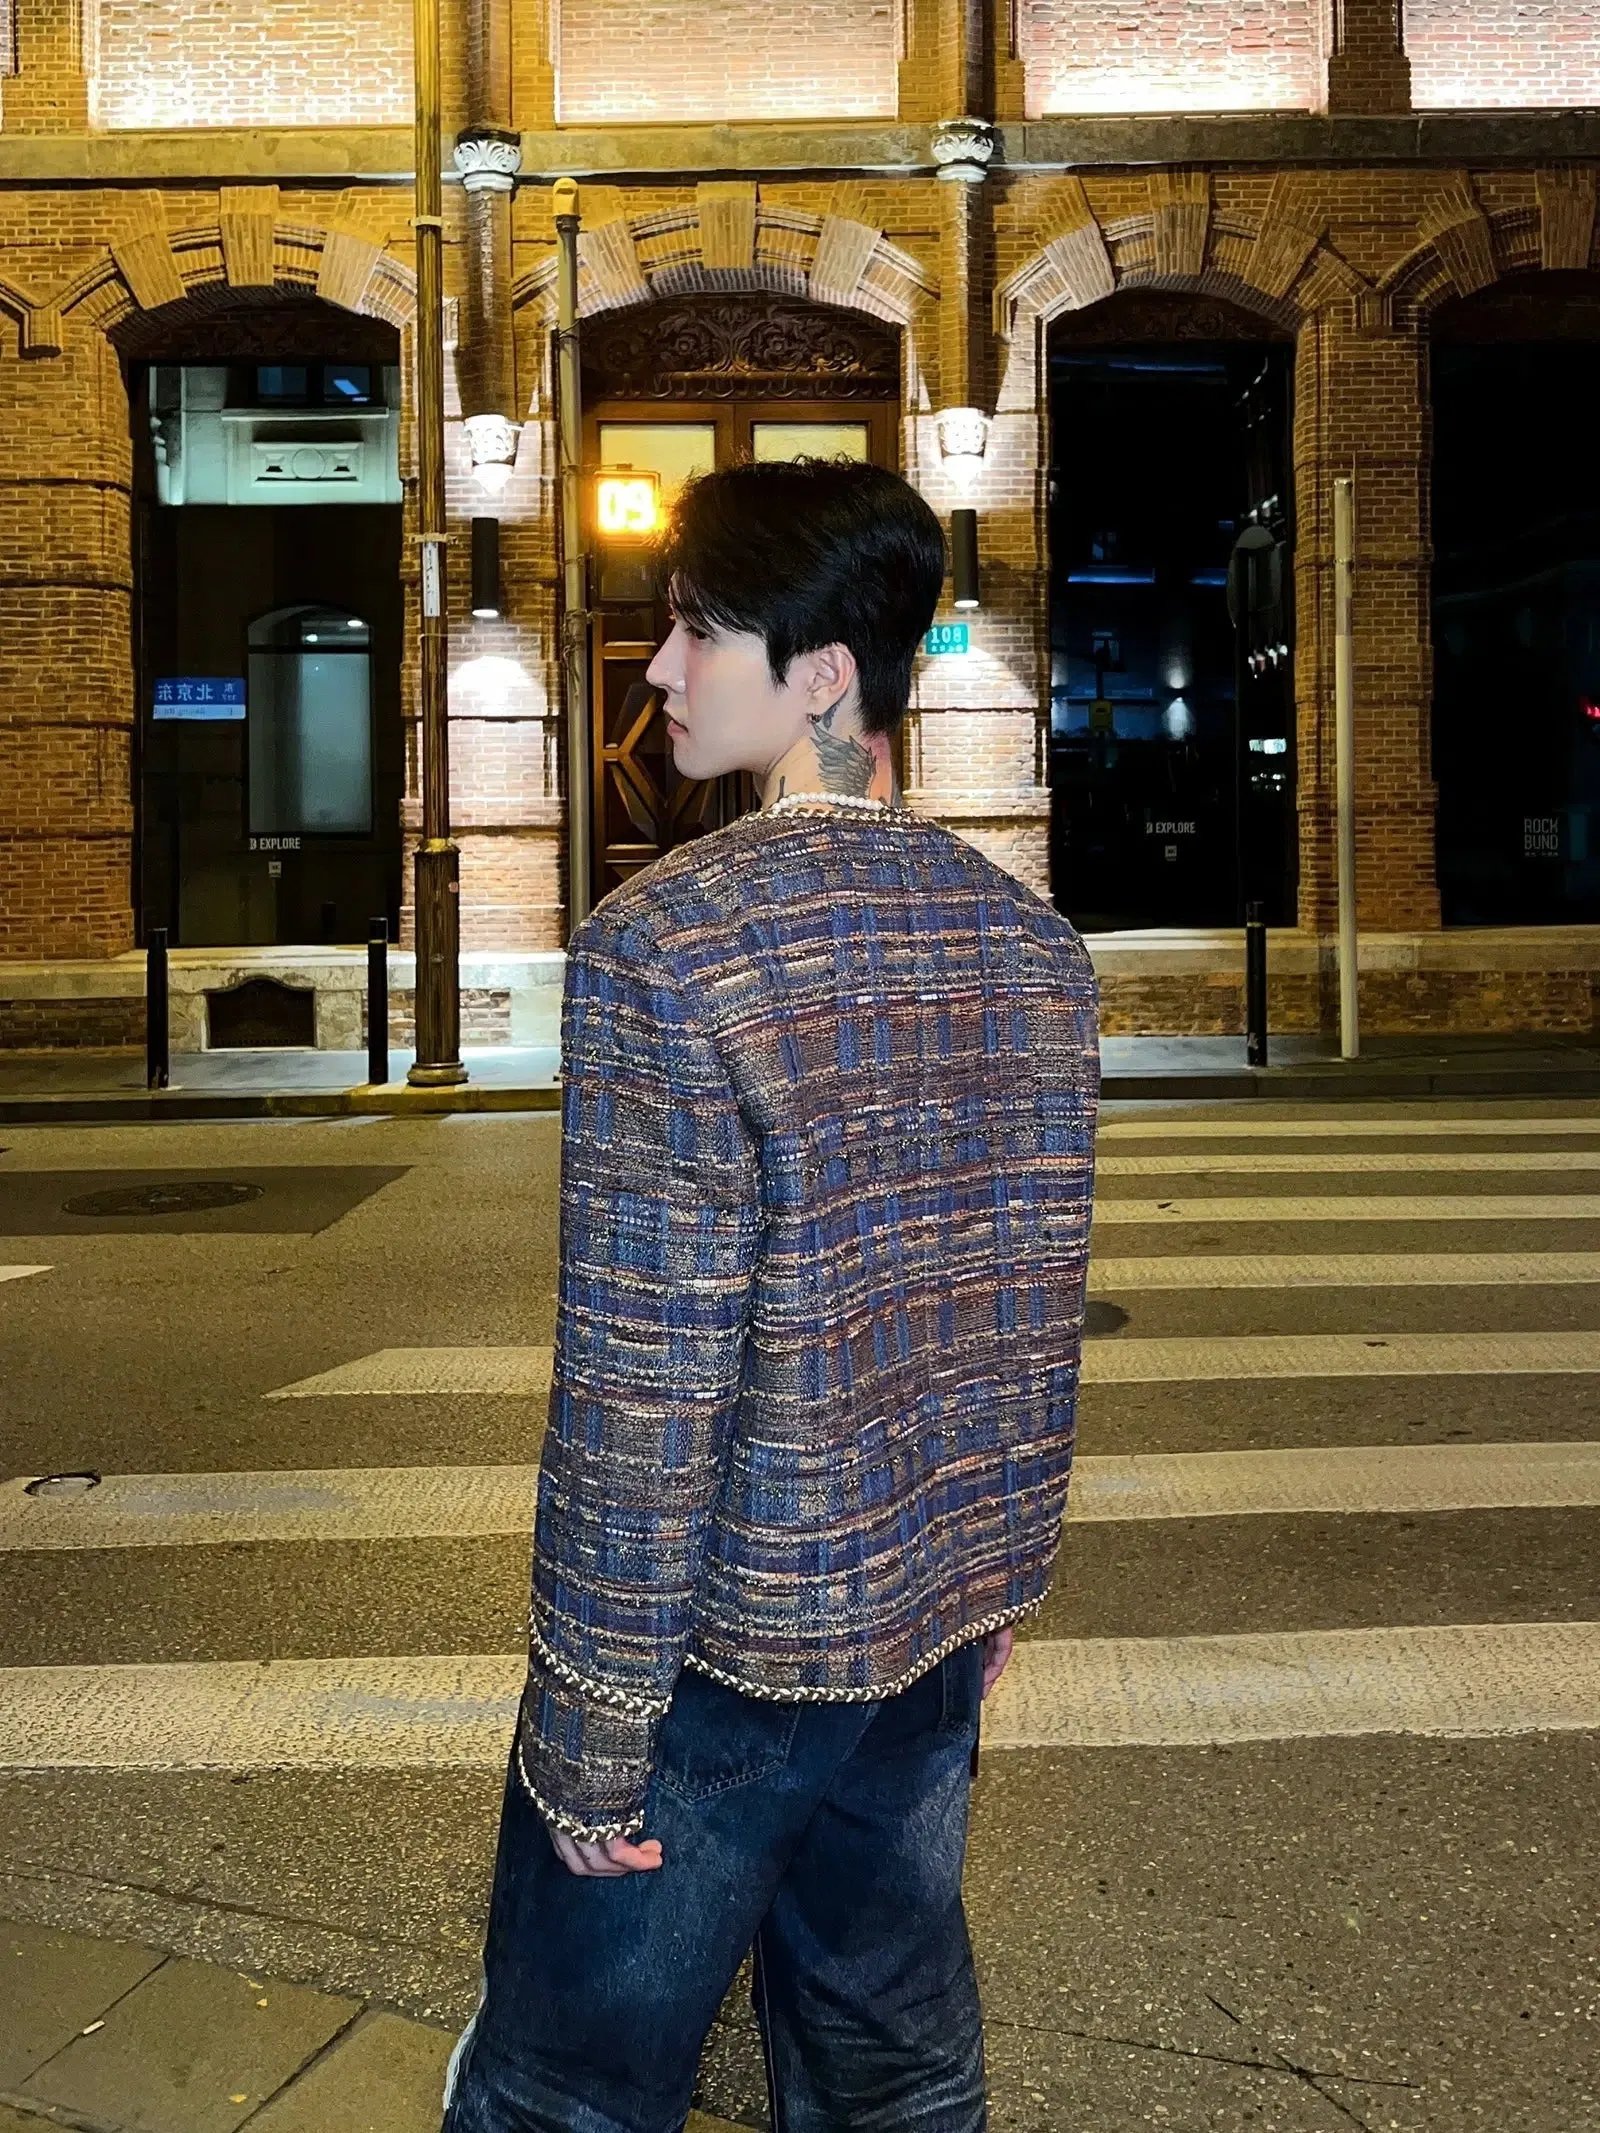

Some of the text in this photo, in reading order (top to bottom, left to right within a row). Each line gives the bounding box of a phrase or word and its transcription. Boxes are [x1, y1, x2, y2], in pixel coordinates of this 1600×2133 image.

[930, 626, 962, 644] 108
[1155, 821, 1196, 834] EXPLORE
[1524, 818, 1558, 833] ROCK
[259, 836, 301, 850] EXPLORE
[1524, 834, 1559, 850] BUND
